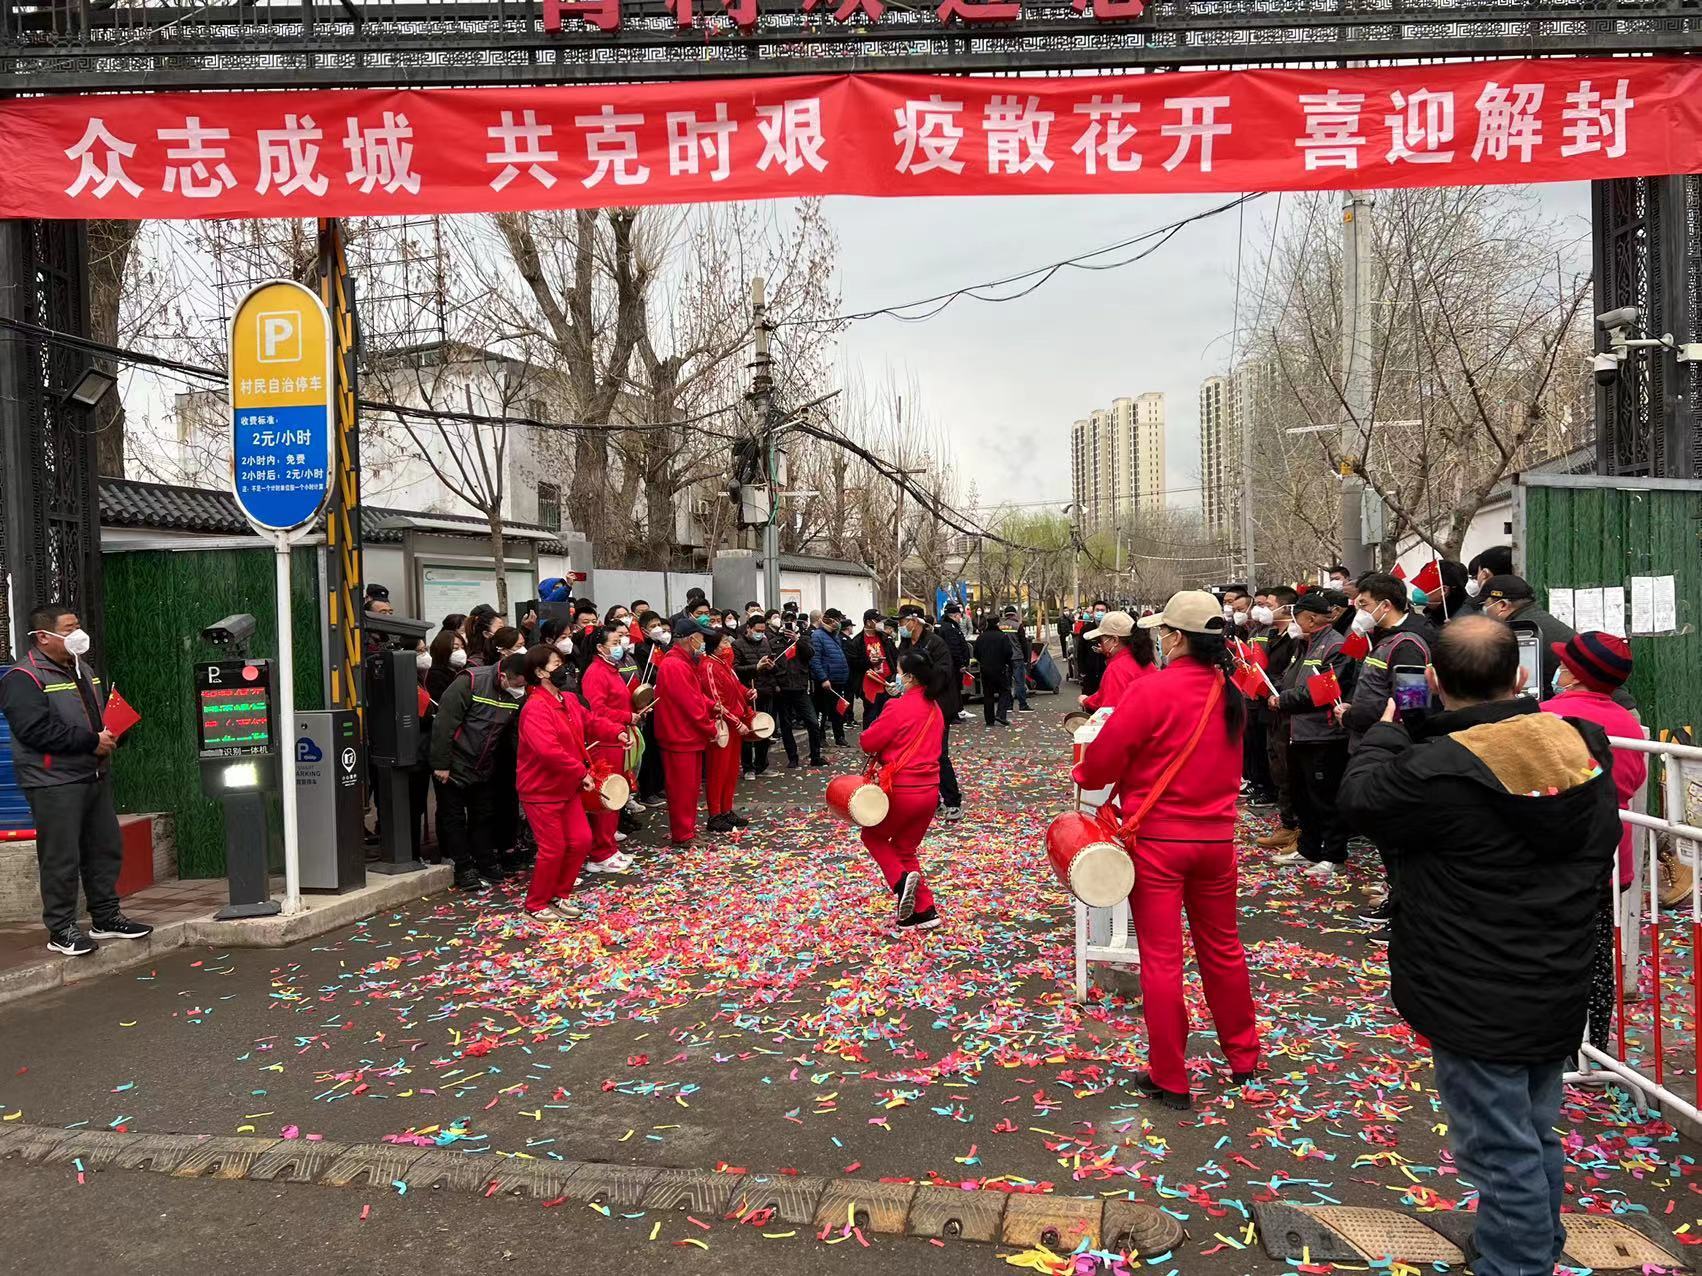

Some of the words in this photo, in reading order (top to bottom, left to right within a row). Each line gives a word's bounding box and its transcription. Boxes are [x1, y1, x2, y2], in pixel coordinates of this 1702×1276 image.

[64, 110, 422, 199] 众志成城
[486, 97, 830, 193] 共克时艰
[893, 93, 1234, 176] 疫散花开
[1294, 78, 1636, 170] 喜迎解封
[265, 317, 294, 357] P
[240, 376, 323, 395] 村民自治停车
[252, 429, 312, 447] 2元/小时
[200, 745, 269, 757] 识别一体机
